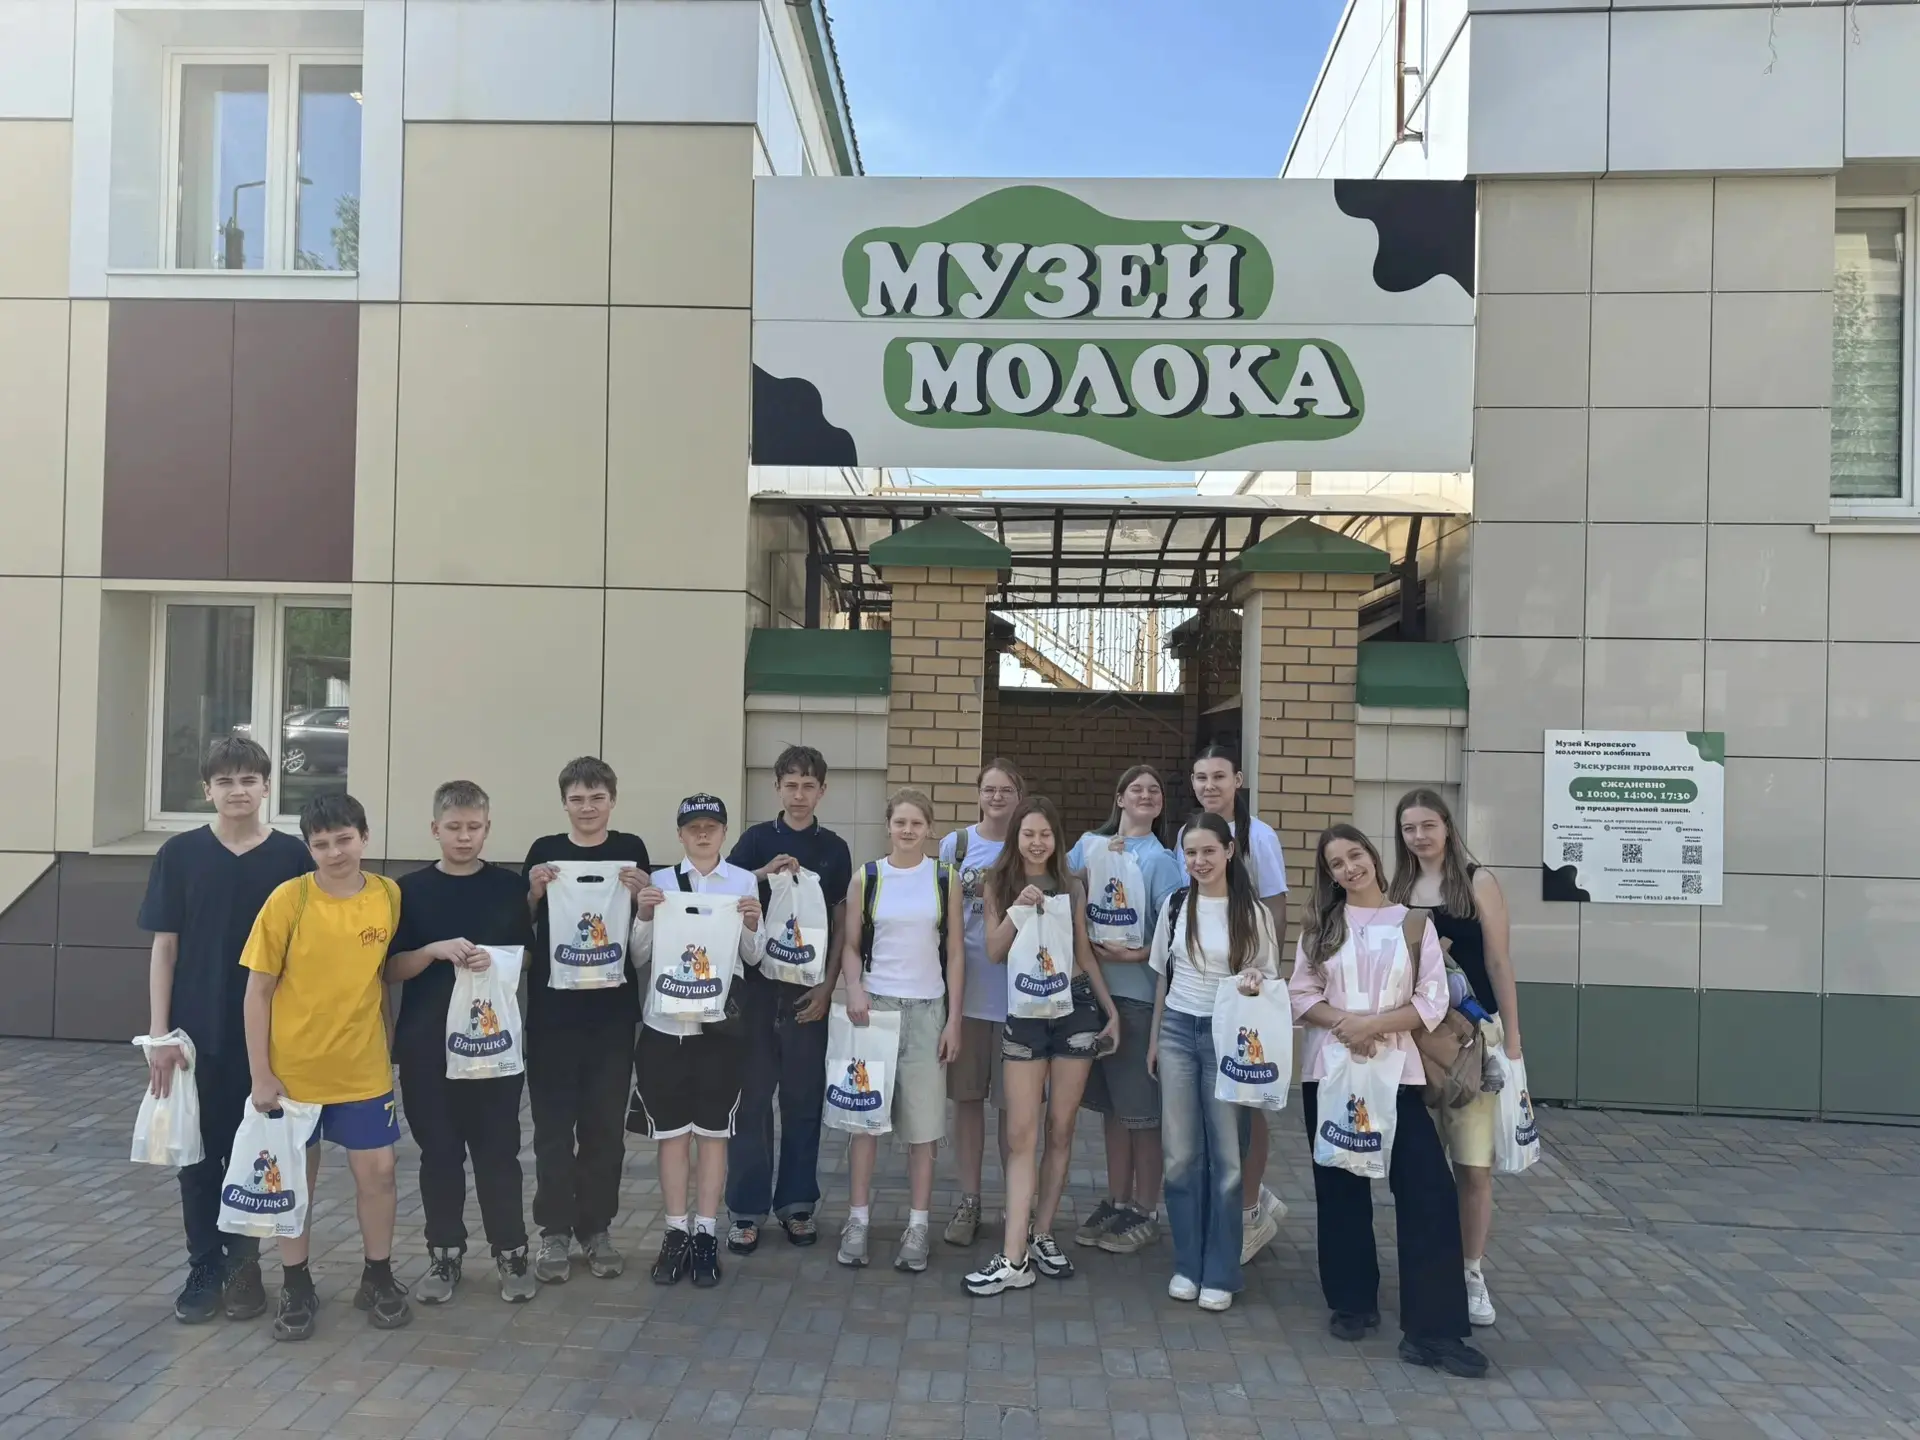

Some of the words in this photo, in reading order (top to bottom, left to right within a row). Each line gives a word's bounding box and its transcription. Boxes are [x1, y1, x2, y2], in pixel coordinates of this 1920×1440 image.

[862, 223, 1248, 320] МУЗЕЙ
[904, 342, 1362, 420] МОЛОКА
[1555, 740, 1582, 748] Музей
[1584, 740, 1637, 749] Кировского
[1603, 749, 1651, 757] комбината
[1573, 761, 1631, 772] Экскурсии
[1633, 764, 1694, 772] проводятся
[1601, 781, 1666, 789] ежедневно
[1587, 790, 1620, 799] 10:00,
[1623, 791, 1657, 800] 14:00,
[1660, 792, 1691, 801] 17:30
[1587, 805, 1658, 813] предварительной
[561, 948, 617, 963] Вятушка
[662, 978, 717, 997] Вятушка
[830, 1088, 877, 1108] Вятушка
[1326, 1125, 1378, 1148] Вятушка
[228, 1188, 289, 1210] Вятушка
